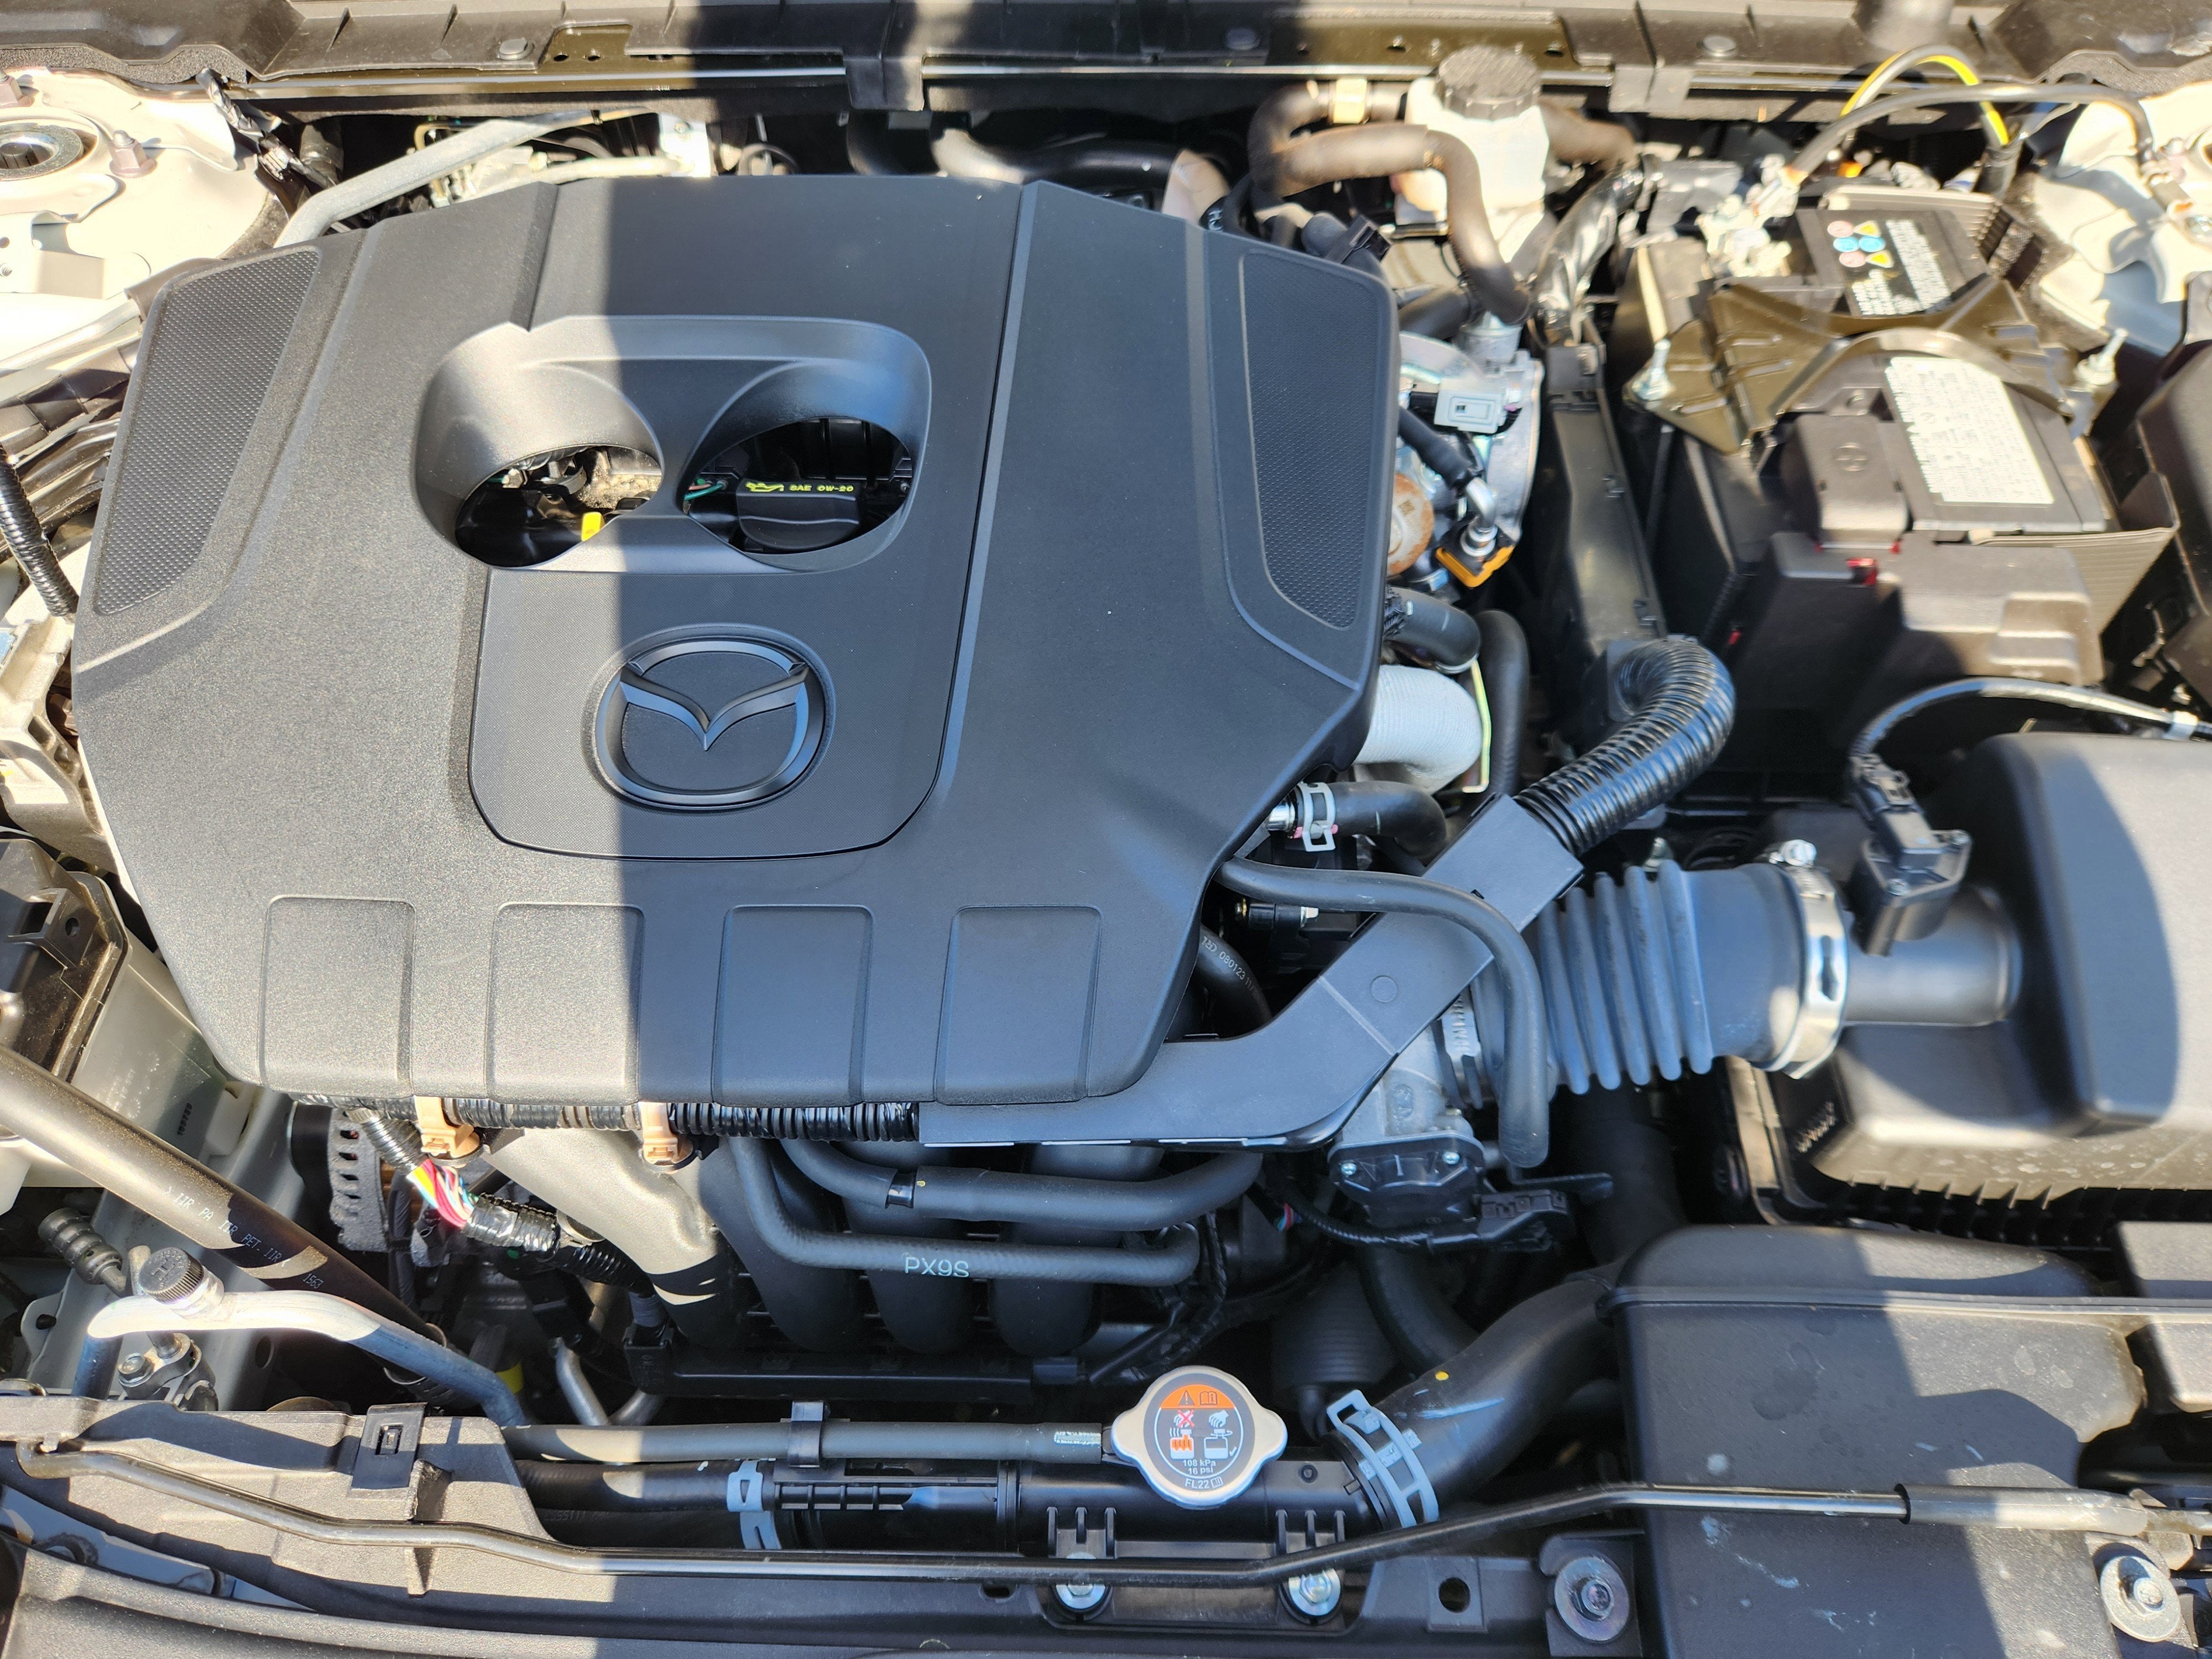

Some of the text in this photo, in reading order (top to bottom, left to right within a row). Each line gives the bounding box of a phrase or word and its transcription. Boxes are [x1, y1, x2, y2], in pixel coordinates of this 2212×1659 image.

[1219, 951, 1245, 980] 080123
[905, 1256, 969, 1277] PX9S
[302, 1272, 324, 1290] 1563
[1200, 1466, 1213, 1474] psi
[1185, 1478, 1210, 1489] FL22
